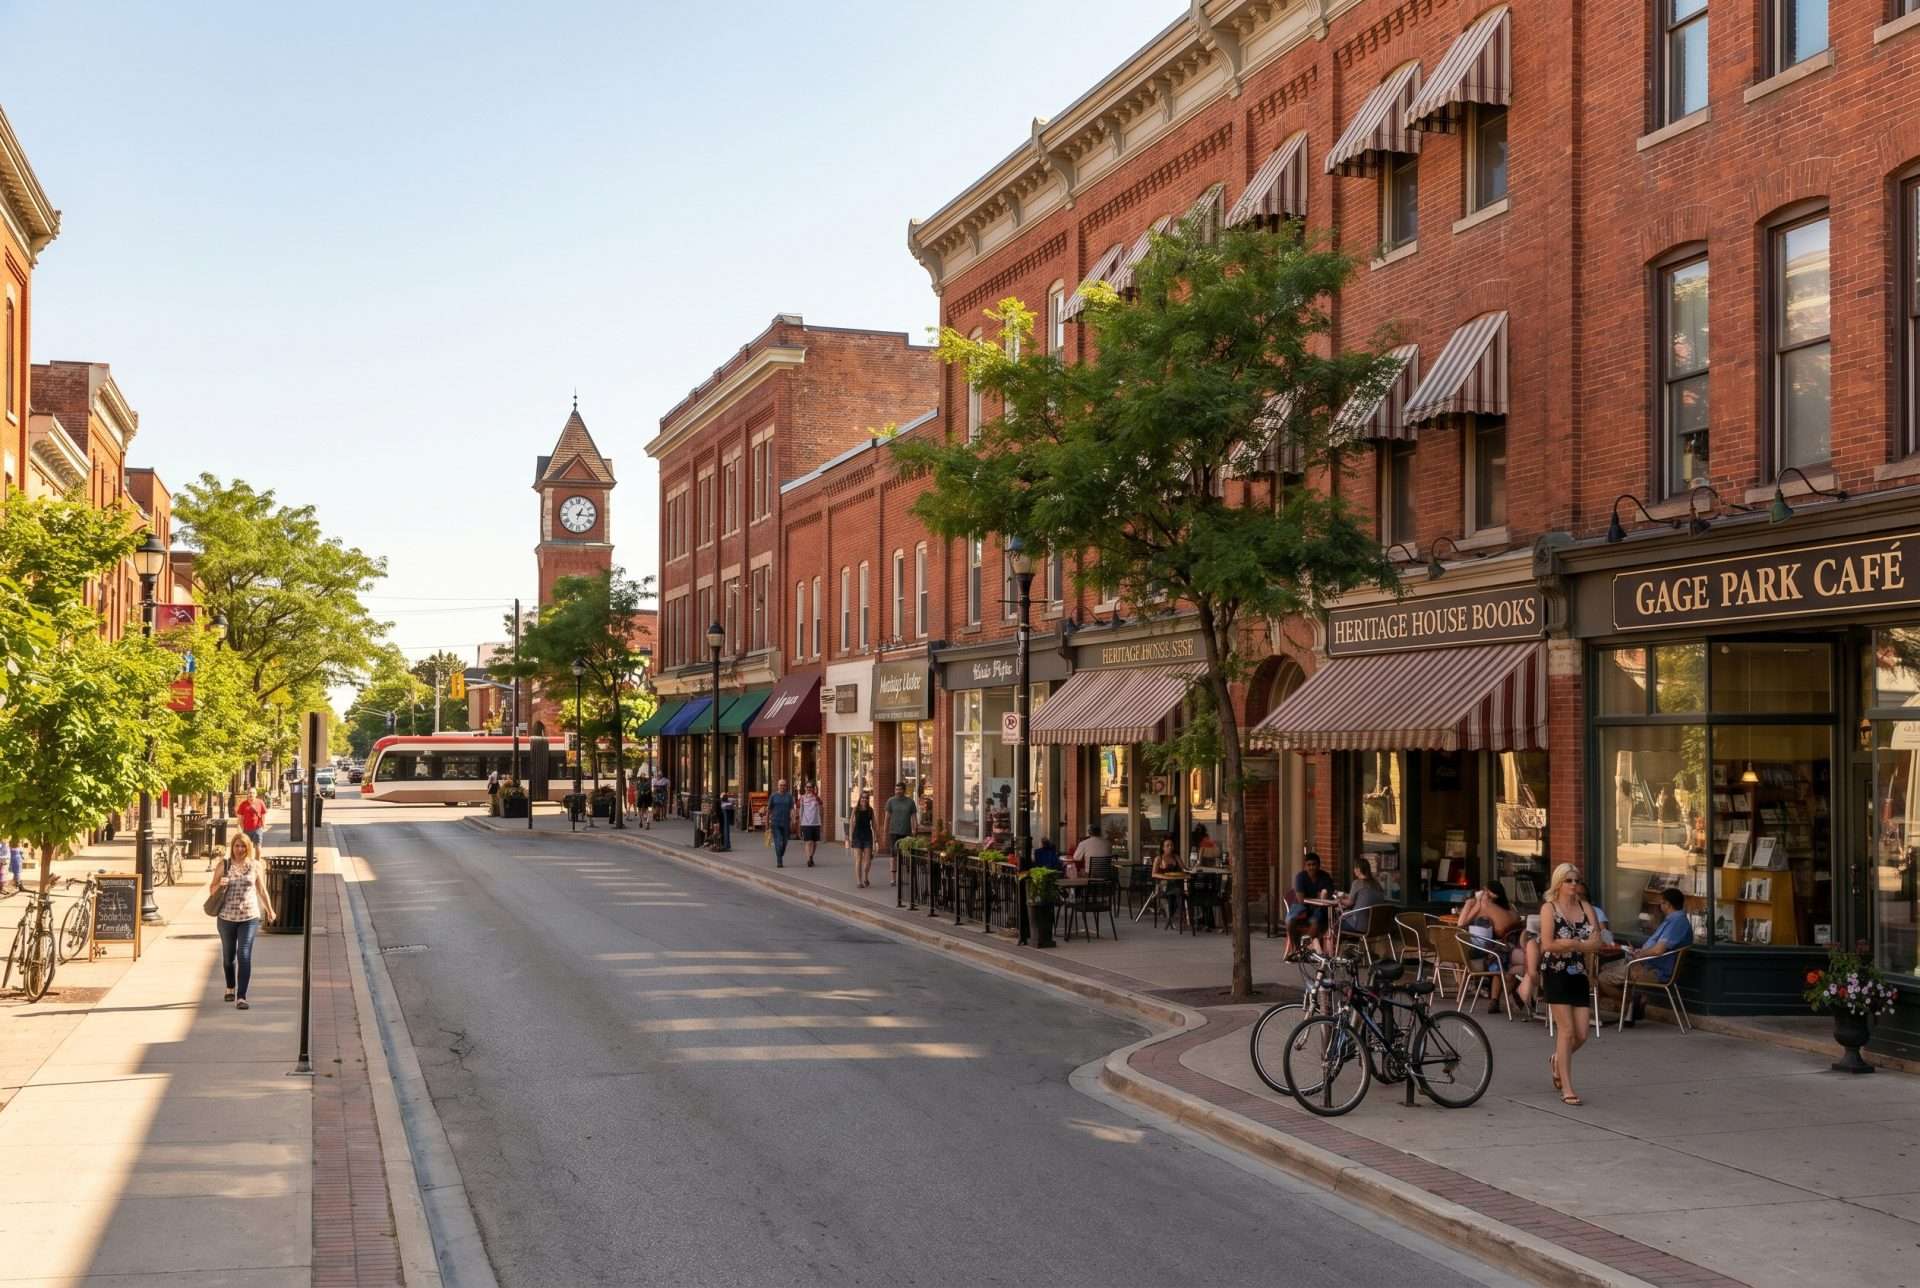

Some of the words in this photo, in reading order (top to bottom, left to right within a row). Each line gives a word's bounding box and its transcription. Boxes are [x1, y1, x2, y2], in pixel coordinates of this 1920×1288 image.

[1635, 575, 1710, 616] GAGE
[1720, 563, 1803, 608] PARK
[1813, 541, 1905, 597] CAFÉ
[1334, 613, 1408, 645] HERITAGE
[1411, 606, 1468, 637] HOUSE
[1472, 597, 1536, 630] BOOKS
